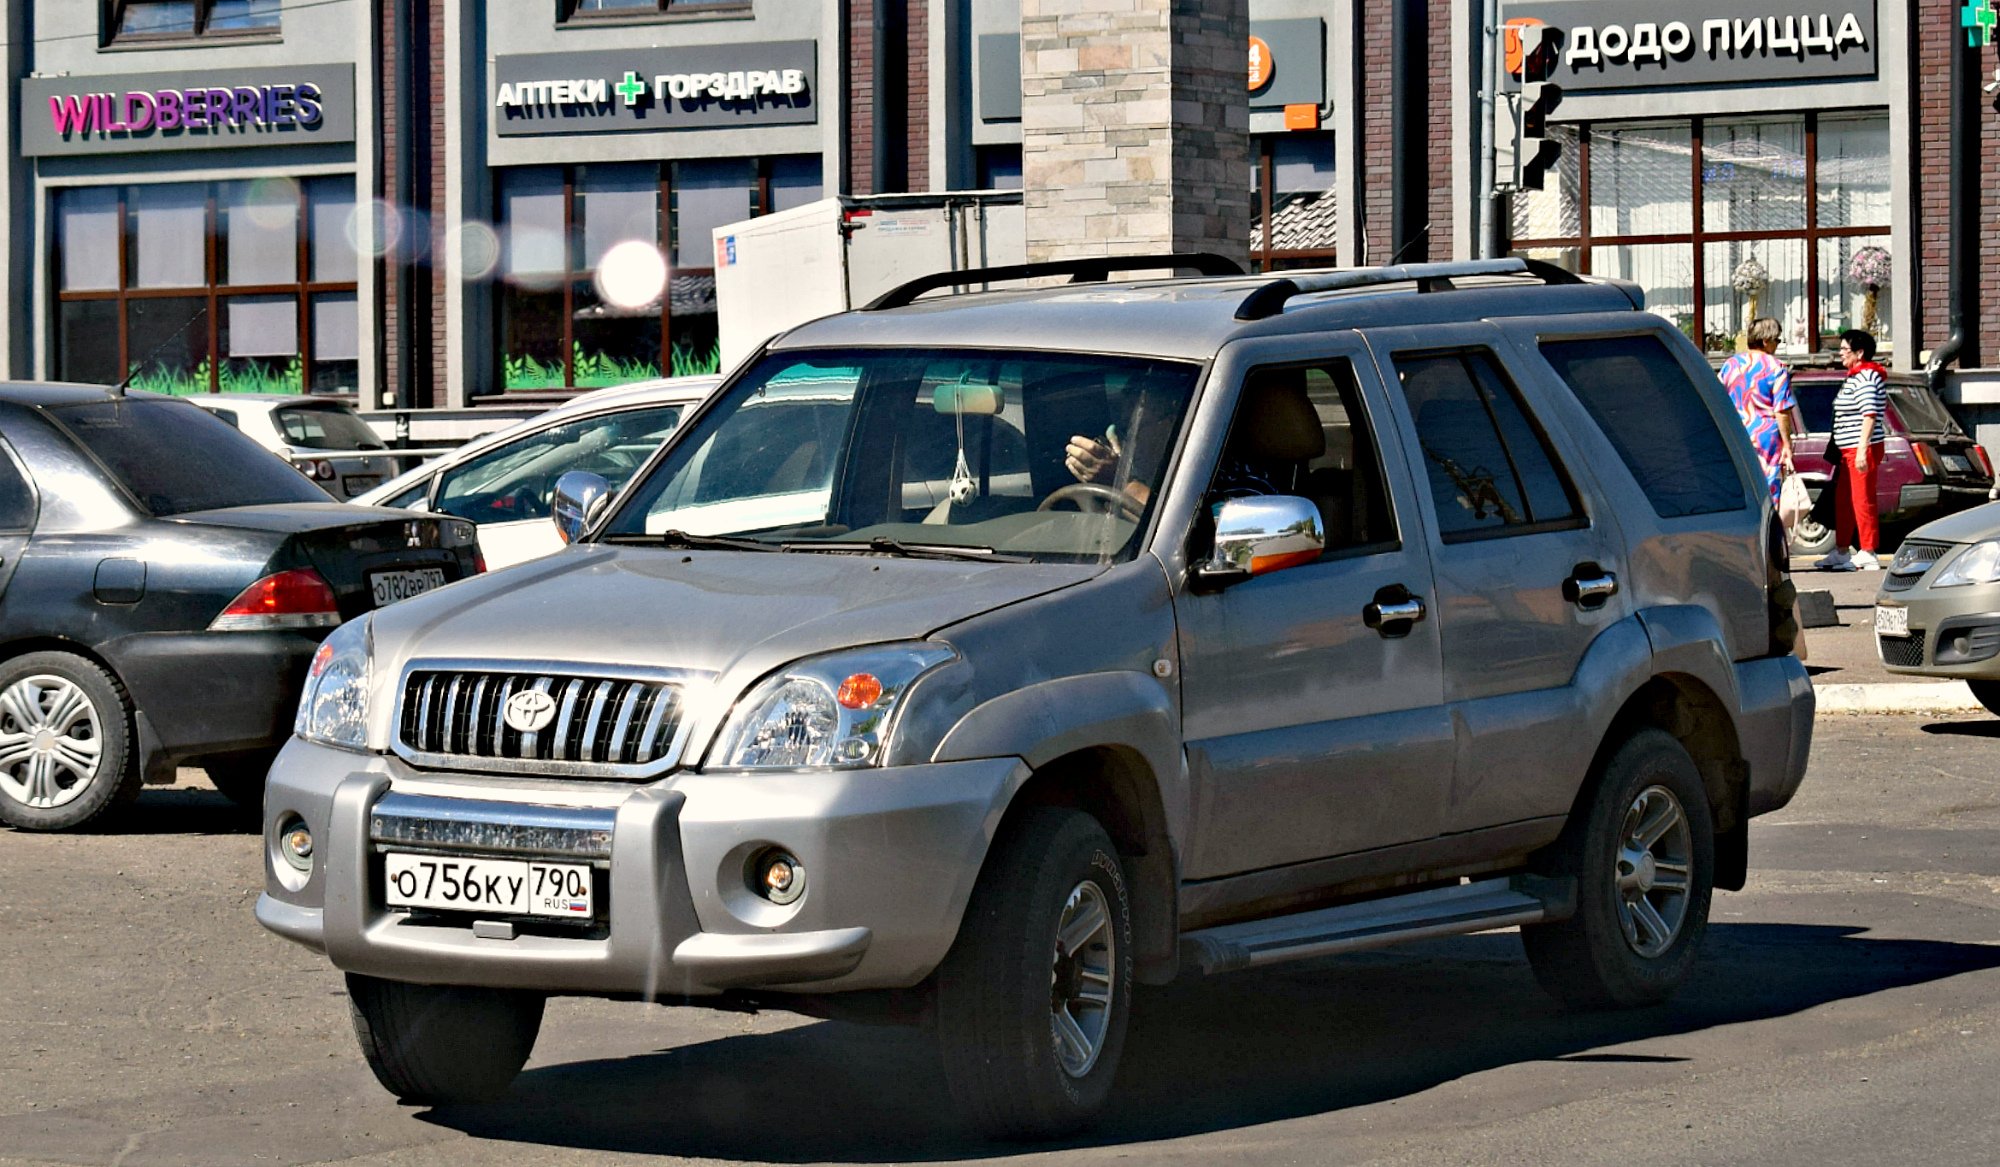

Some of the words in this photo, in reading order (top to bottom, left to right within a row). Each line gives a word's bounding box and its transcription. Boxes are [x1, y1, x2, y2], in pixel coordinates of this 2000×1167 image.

[1566, 21, 1691, 66] ДОДО
[1702, 12, 1865, 54] ПИЦЦА
[49, 82, 323, 135] WILDBERRIES
[496, 79, 606, 106] АПТЕКИ
[655, 69, 804, 100] ГОРЗДРАВ
[397, 861, 524, 905] О756КУ
[532, 866, 581, 898] 790
[544, 898, 569, 910] RUS
